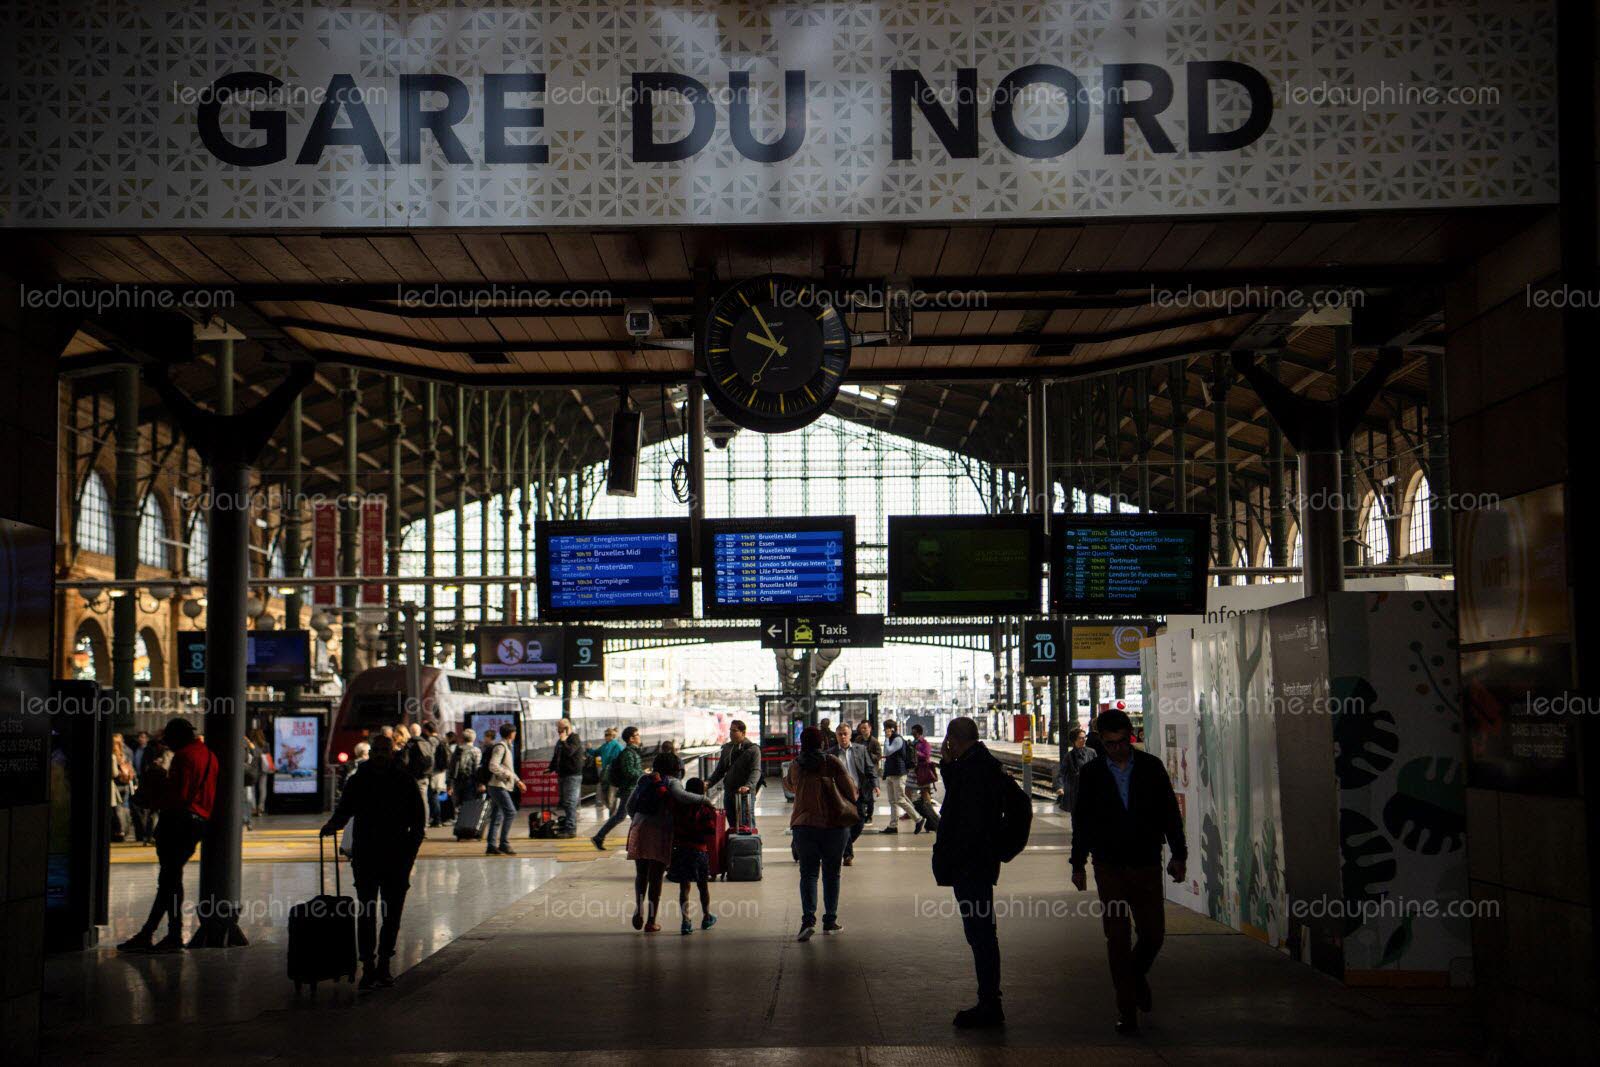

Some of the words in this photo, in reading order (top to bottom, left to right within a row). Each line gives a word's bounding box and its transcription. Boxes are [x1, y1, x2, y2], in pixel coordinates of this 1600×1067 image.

[199, 70, 549, 166] GARE
[631, 70, 806, 163] DU
[891, 61, 1274, 160] NORD
[594, 536, 640, 544] Enregistrement
[824, 541, 838, 602] départs
[594, 578, 630, 586] Compiègne
[596, 592, 642, 600] Enregistrement
[819, 624, 848, 635] Taxis
[579, 646, 592, 664] 9
[1032, 642, 1056, 659] 10
[192, 652, 205, 670] 8
